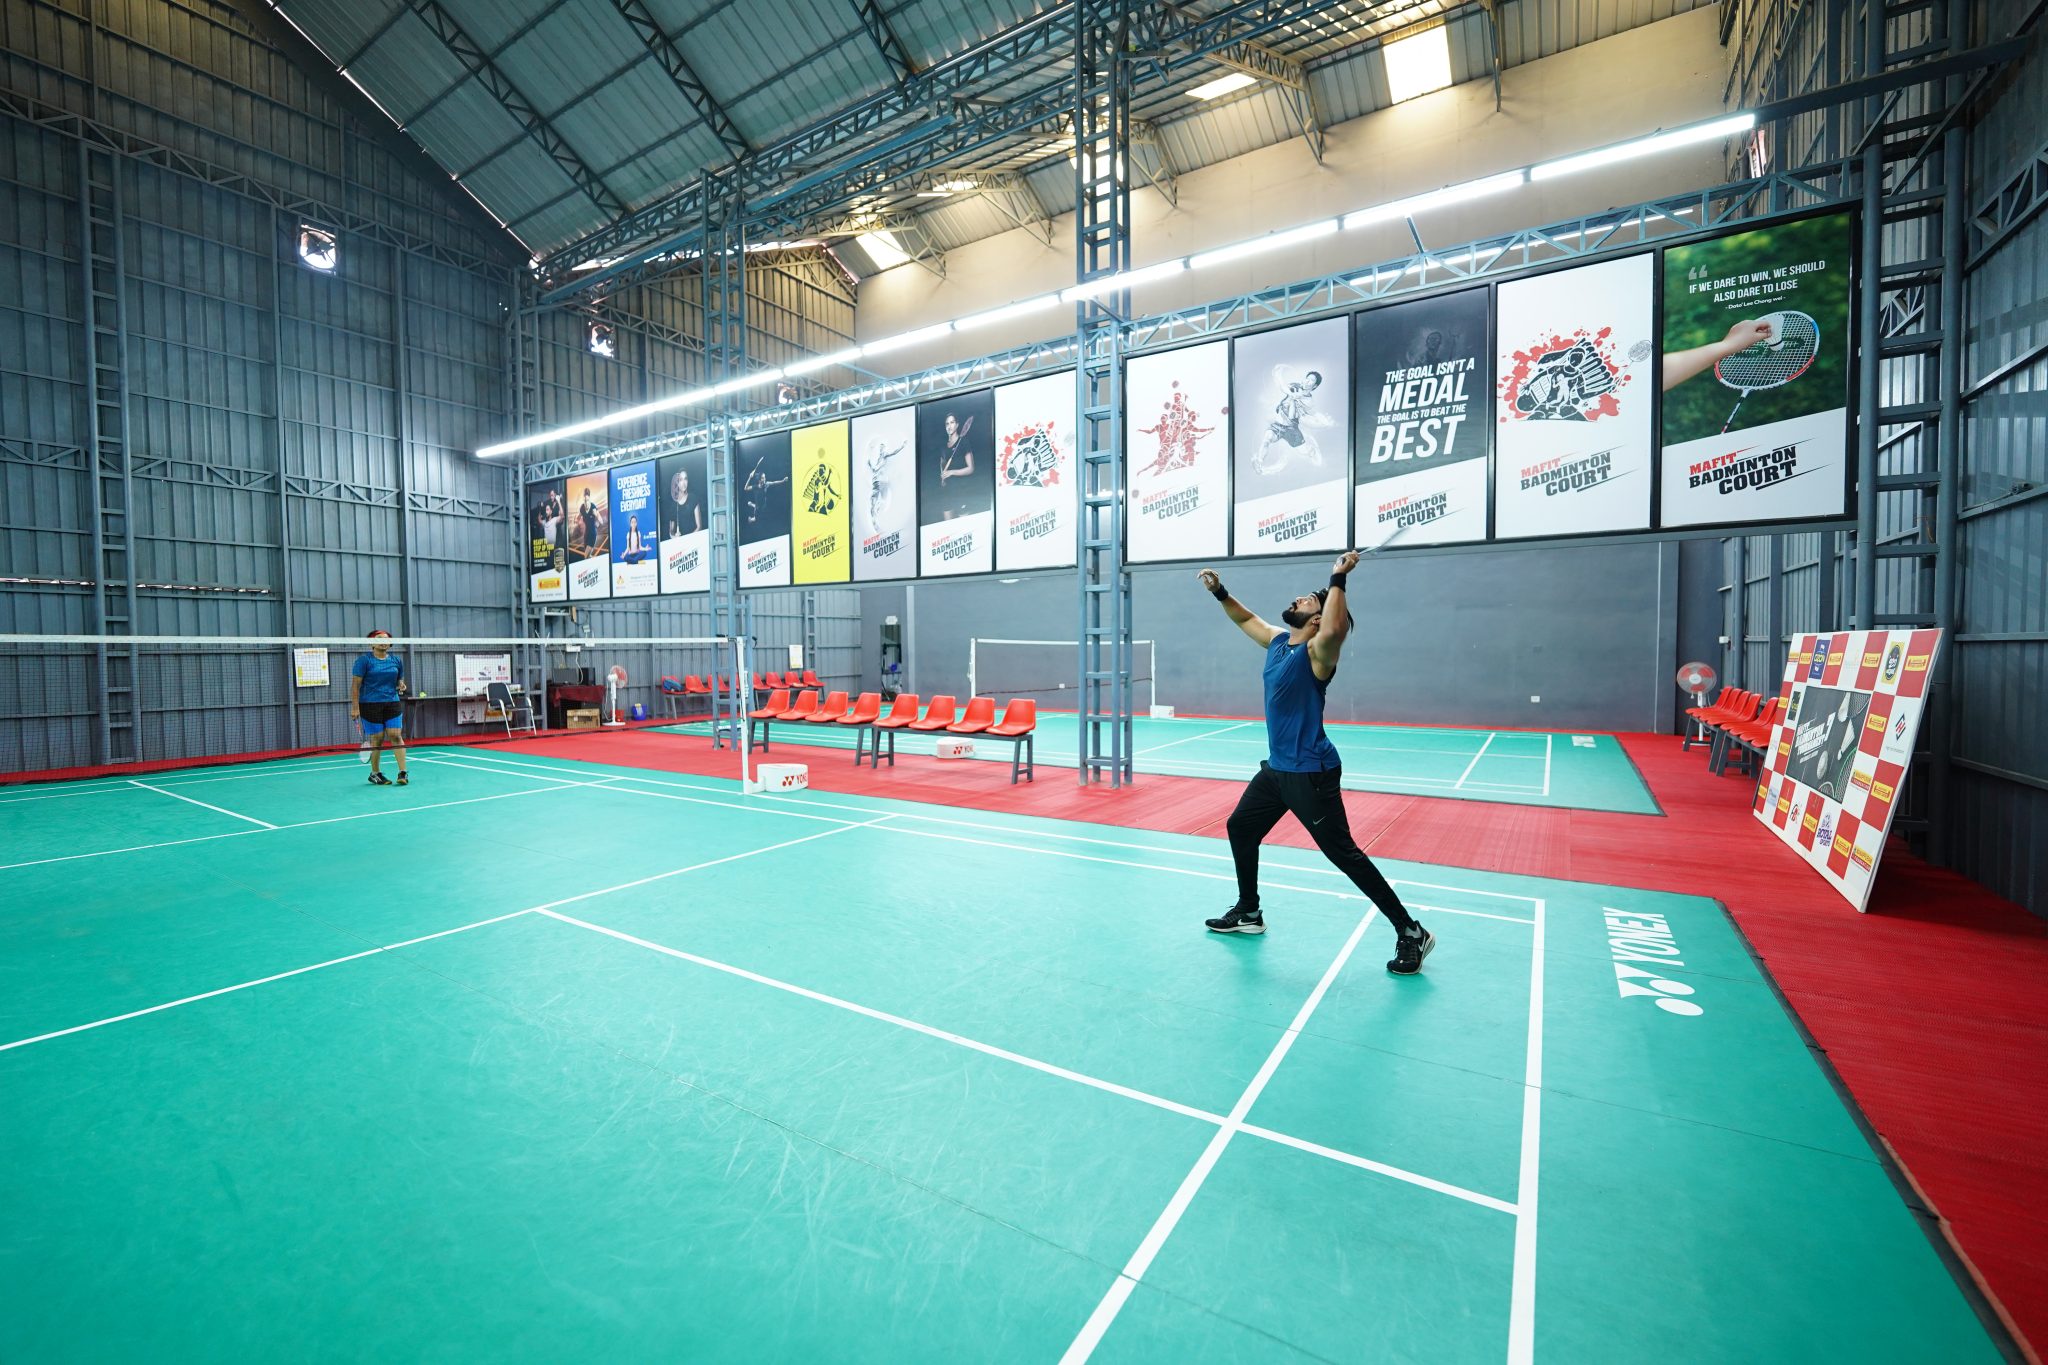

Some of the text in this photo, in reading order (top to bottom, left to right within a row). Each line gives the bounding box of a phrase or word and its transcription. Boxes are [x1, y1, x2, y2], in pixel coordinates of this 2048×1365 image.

[1689, 260, 1826, 294] IF WE DARE TO WIN, WE SHOULD
[1713, 279, 1798, 303] ALSO DARE TO LOSE
[1385, 357, 1475, 384] THE GOAL ISN'T A
[1378, 373, 1469, 414] MEDAL
[1377, 403, 1467, 425] THE GOAL IS TO BEAT THE
[1369, 414, 1467, 464] BEST
[1520, 452, 1611, 491] BADMINTON
[1521, 458, 1561, 478] MAFIT
[1689, 446, 1797, 489] BADMINTON
[1690, 452, 1737, 476] MAFIT
[617, 472, 647, 490] EXPERIENCE
[1545, 464, 1611, 497] COURT
[1718, 459, 1797, 495] COURT
[622, 484, 651, 500] FRESHNESS
[1142, 489, 1169, 505] MAFIT
[1142, 486, 1199, 515] BADMINTON
[1158, 496, 1199, 520] COURT
[1377, 493, 1447, 523] BADMINTON
[1378, 497, 1409, 513] MAFIT
[1397, 503, 1447, 528] COURT
[1010, 513, 1030, 527] MAFIT
[1010, 509, 1056, 536] BADMINTON
[1023, 519, 1056, 541] COURT
[1257, 510, 1317, 538] BADMINTON
[1258, 513, 1285, 528] MAFIT
[802, 537, 818, 547] MAFIT
[863, 534, 880, 546] MAFIT
[931, 536, 950, 548] MAFIT
[1274, 520, 1317, 543] COURT
[802, 534, 836, 555] BADMINTON
[812, 543, 836, 560] COURT
[863, 532, 900, 554] BADMINTON
[873, 540, 900, 559] COURT
[931, 533, 973, 556] BADMINTON
[943, 541, 973, 561] COURT
[669, 549, 698, 570] BADMINTON
[677, 558, 698, 575] COURT
[747, 552, 761, 562] MAFIT
[747, 551, 777, 570] BADMINTON
[755, 560, 777, 574] COURT
[584, 575, 598, 588] COURT
[1602, 906, 1685, 967] YONEX
